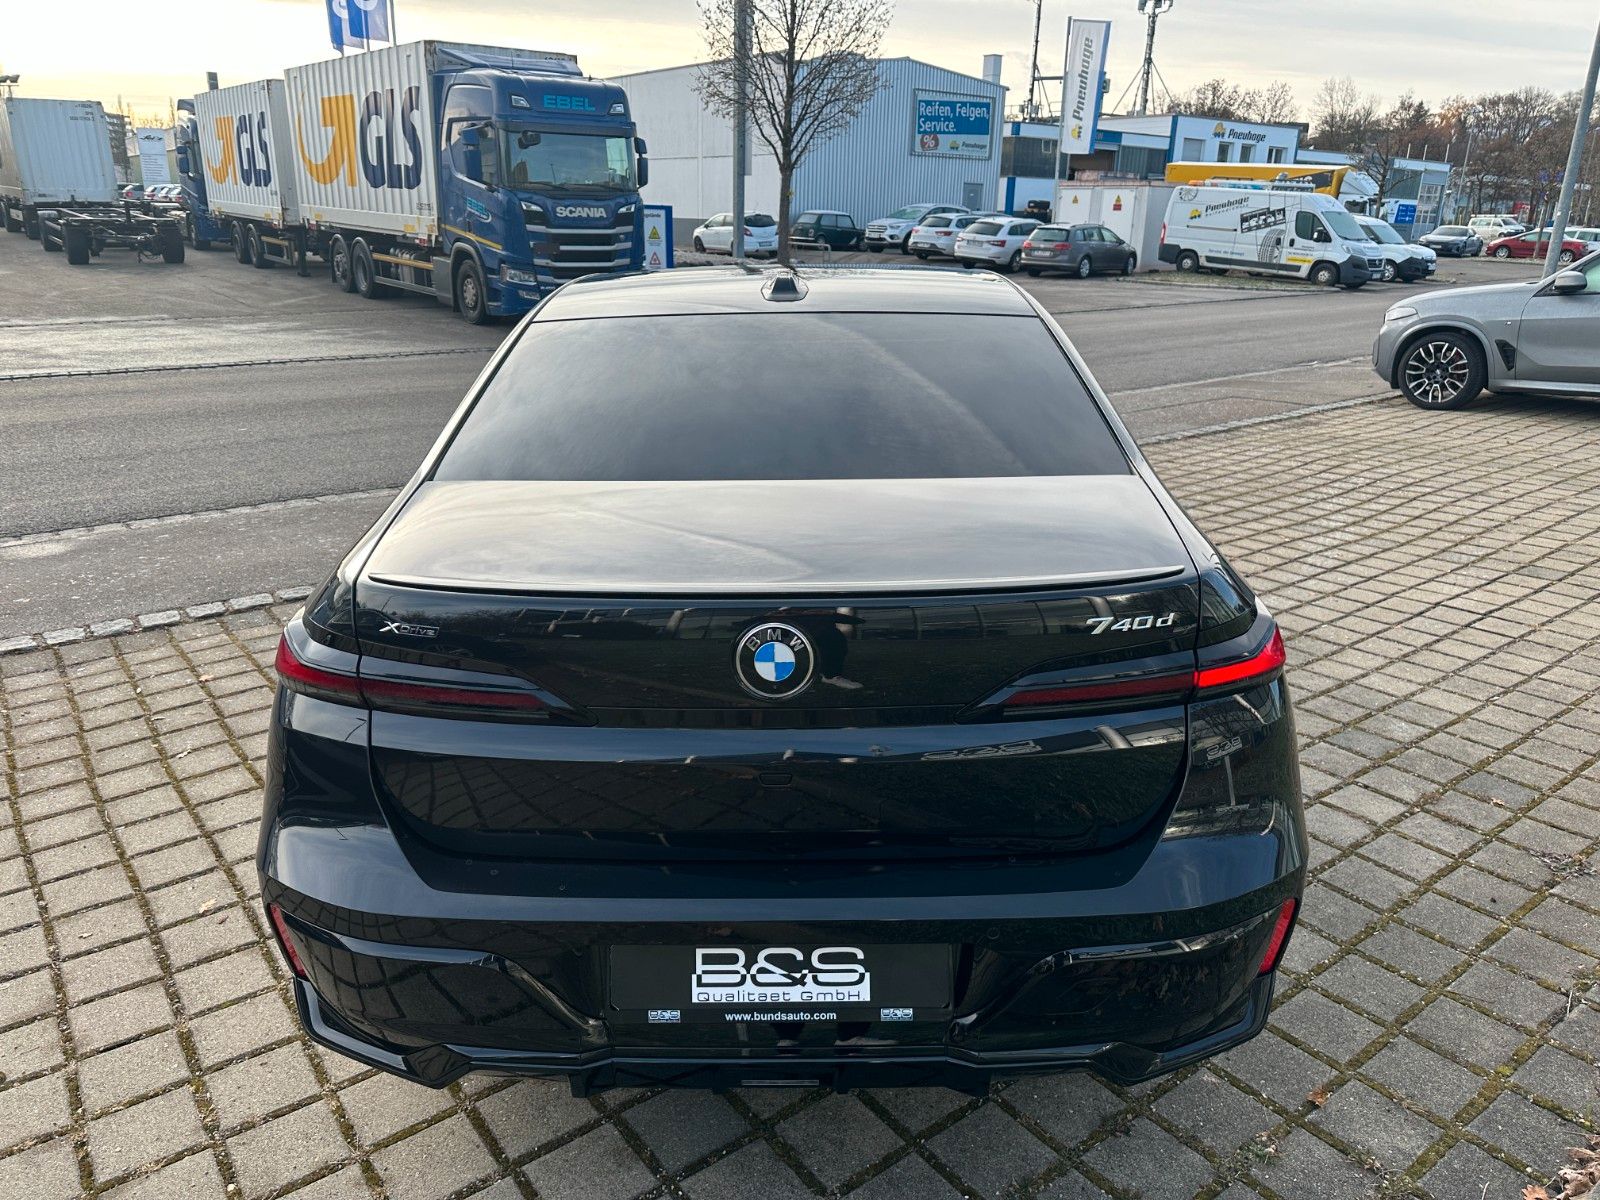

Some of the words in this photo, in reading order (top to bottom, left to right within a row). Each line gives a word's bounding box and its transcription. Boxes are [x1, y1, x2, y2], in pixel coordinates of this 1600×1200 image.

[1072, 36, 1094, 122] Pneuhage
[543, 94, 596, 112] EBEL
[919, 101, 954, 118] Reifen,
[955, 102, 989, 121] Felgen,
[919, 117, 957, 132] Service.
[359, 86, 422, 190] GLS
[1227, 128, 1267, 143] Pneuhage
[236, 110, 272, 187] GLS
[556, 206, 607, 218] SCANIA
[745, 628, 805, 652] BMW
[695, 946, 866, 988] B&S
[696, 989, 791, 1002] Qualitaet
[725, 1011, 837, 1021] www.bundsauto.com
